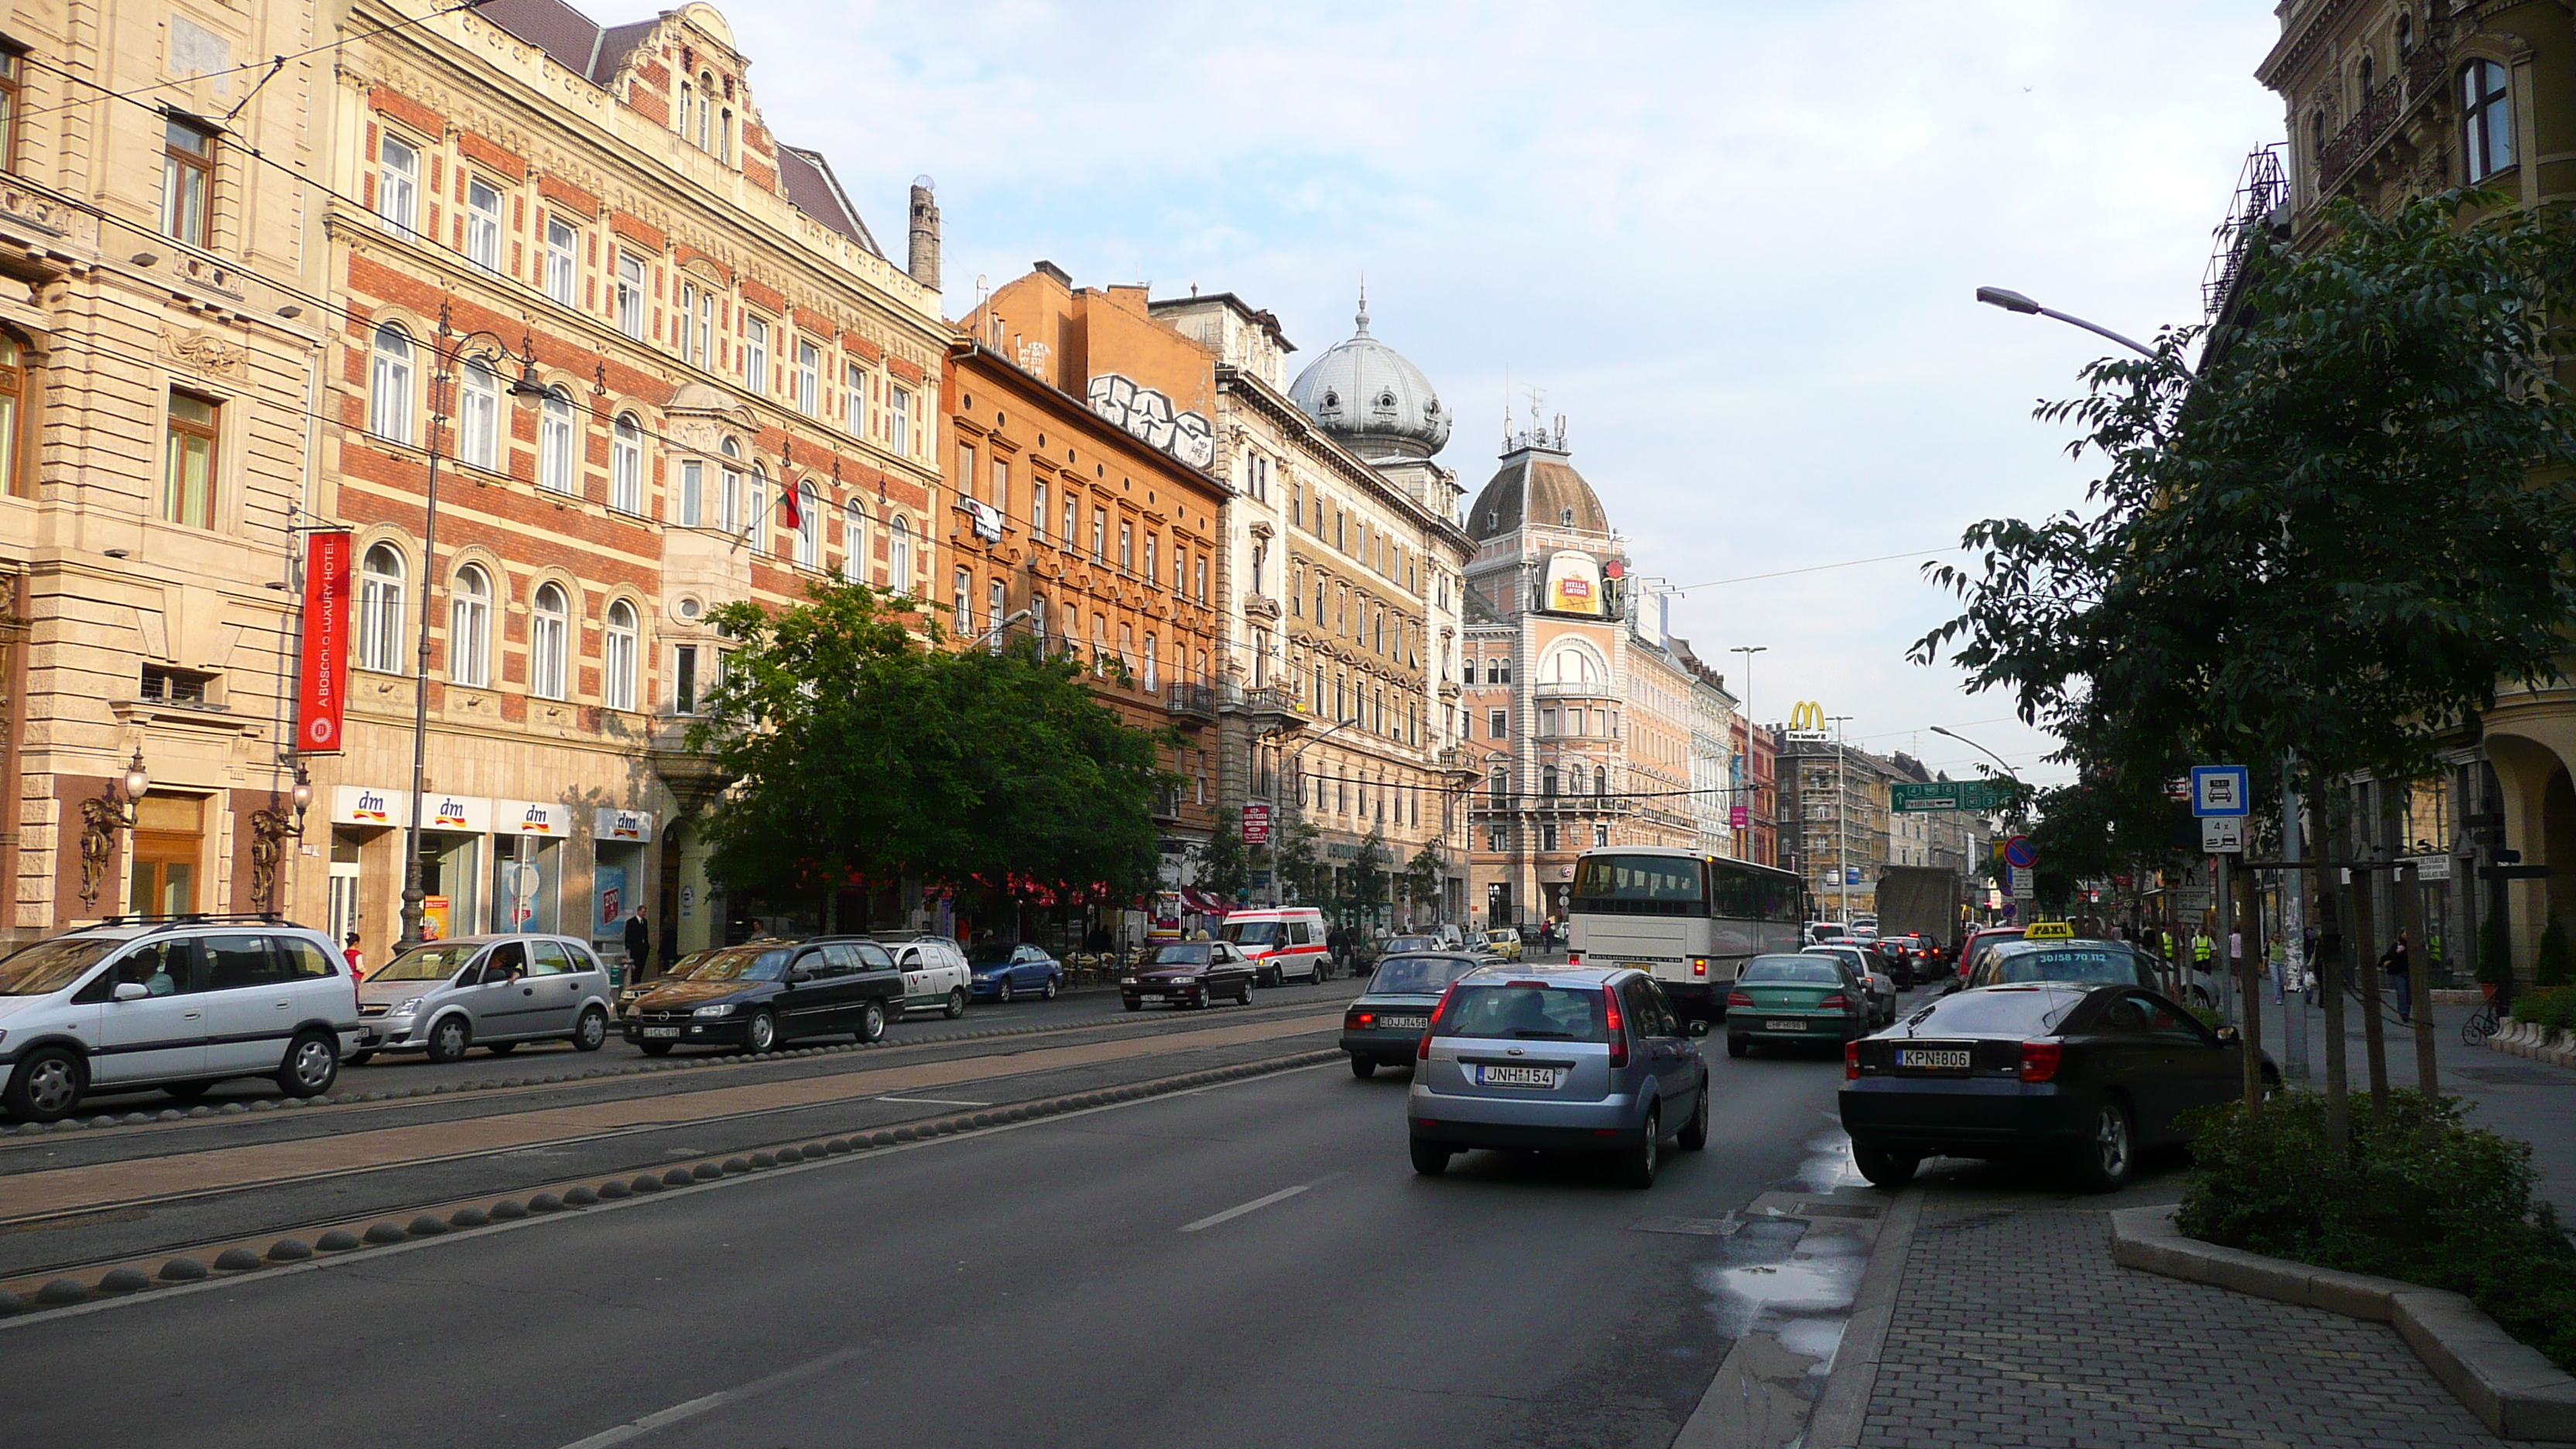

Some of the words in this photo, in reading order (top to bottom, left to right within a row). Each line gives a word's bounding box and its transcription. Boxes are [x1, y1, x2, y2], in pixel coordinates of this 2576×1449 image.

[324, 540, 335, 580] HOTEL
[323, 583, 334, 632] LUXURY
[319, 635, 331, 697] BOSCOLO
[318, 698, 328, 707] A
[358, 791, 384, 810] dm
[440, 798, 464, 817] dm
[526, 804, 547, 822] dm
[618, 813, 636, 830] dm
[605, 891, 618, 908] 200
[2033, 925, 2066, 934] TAXI
[2040, 954, 2071, 963] 30/58
